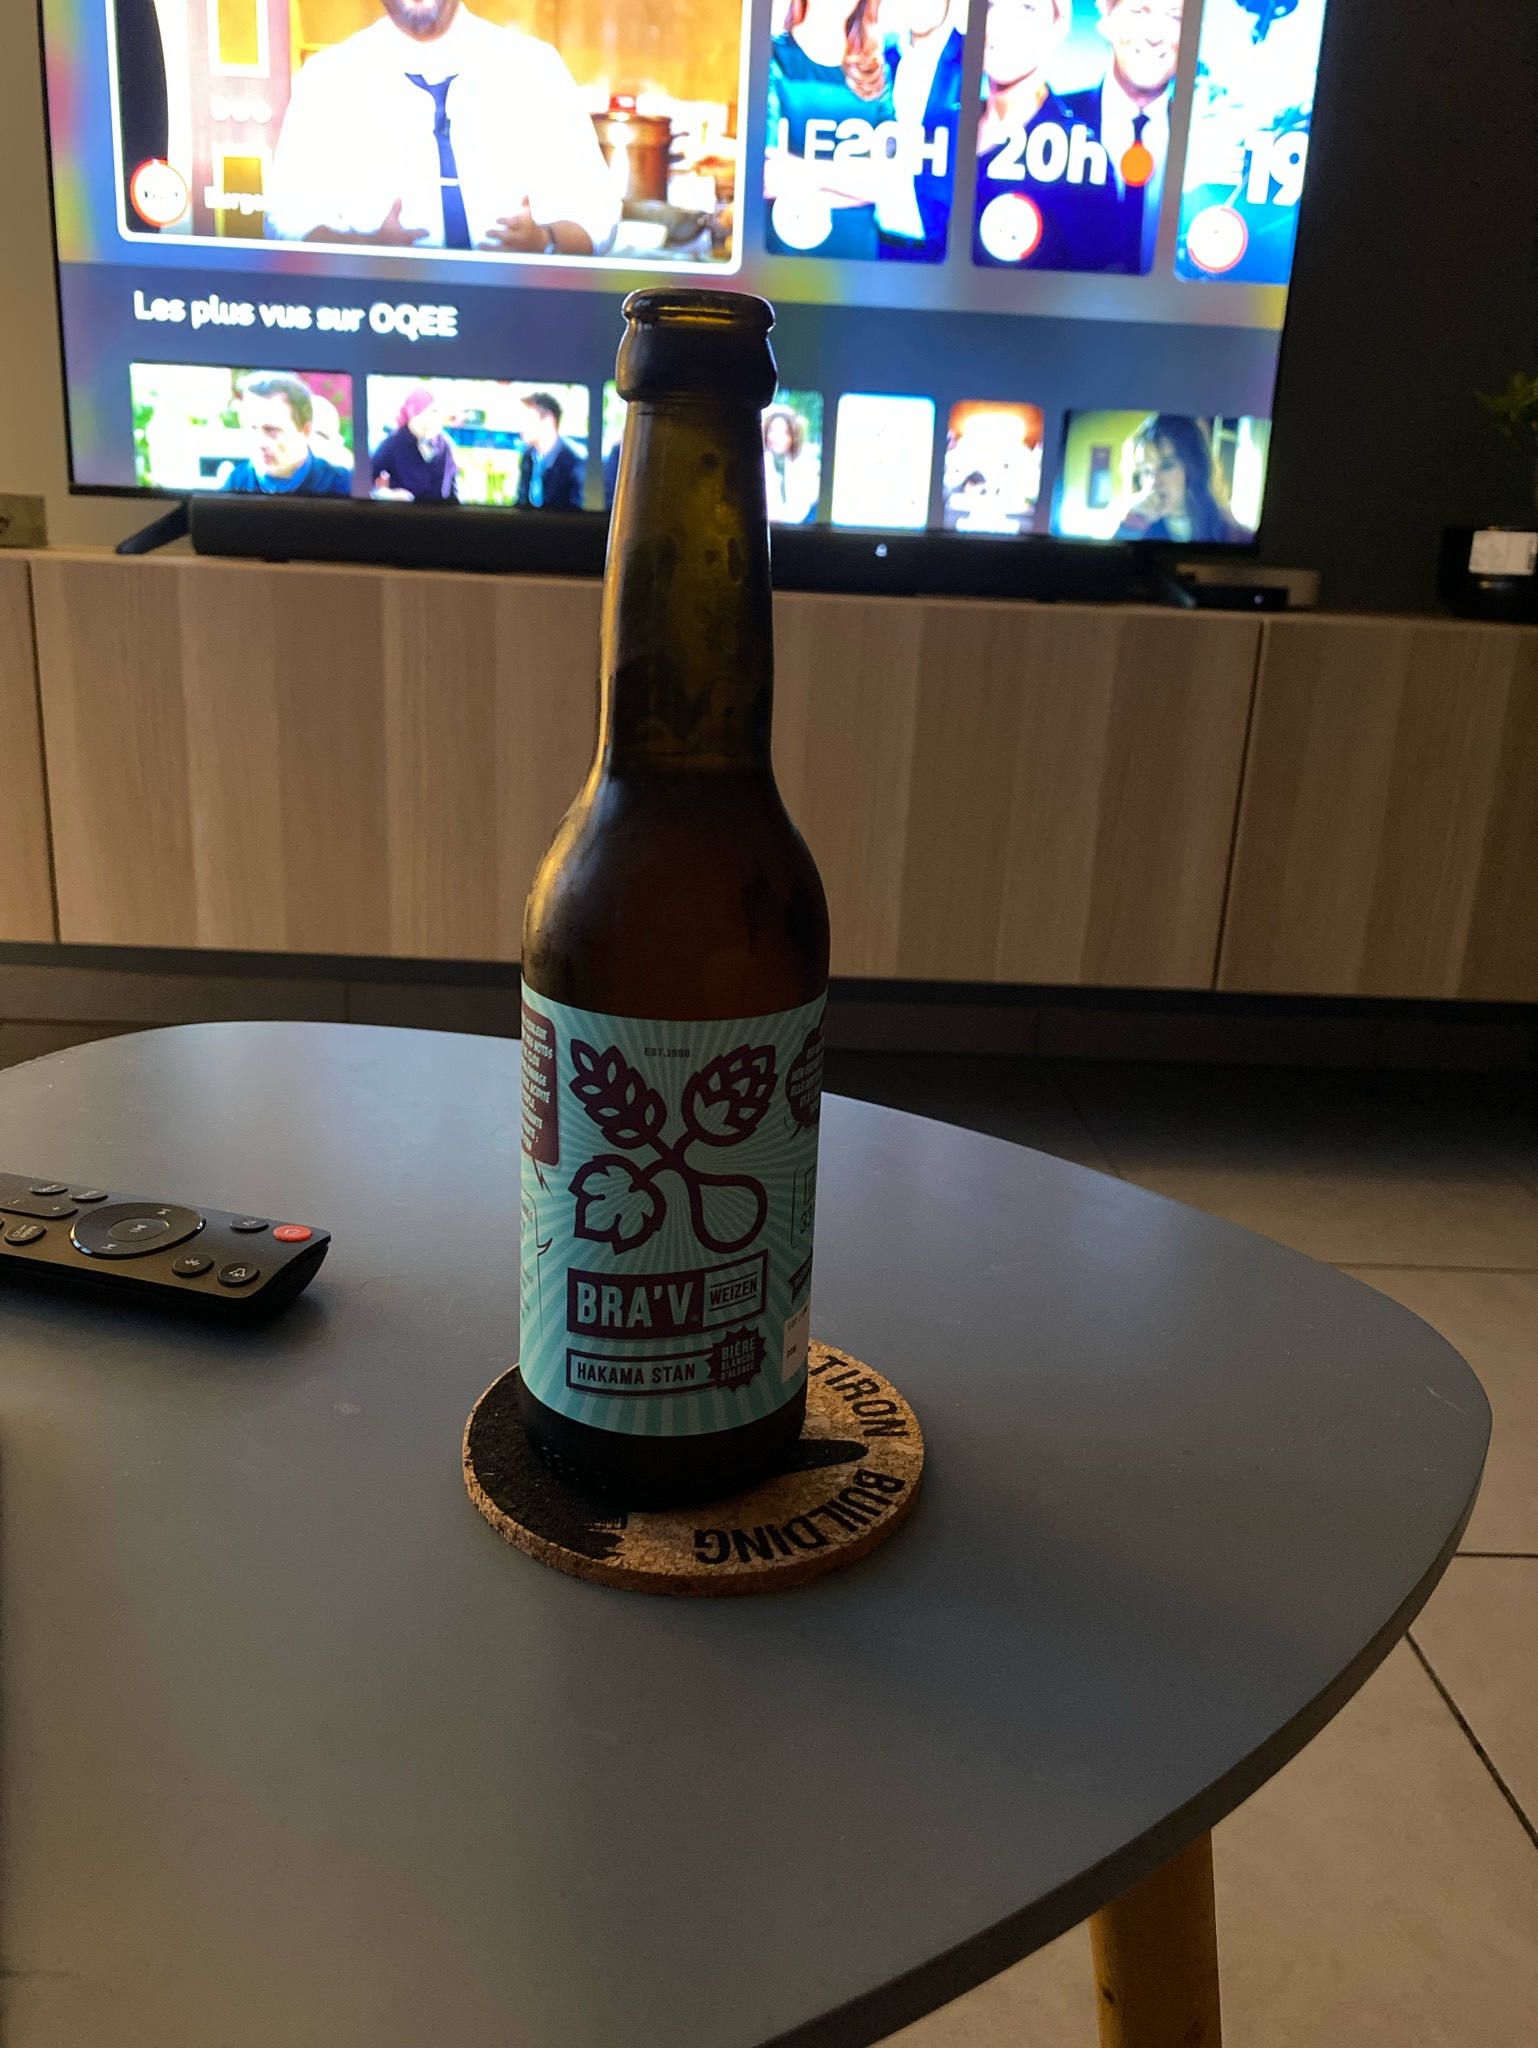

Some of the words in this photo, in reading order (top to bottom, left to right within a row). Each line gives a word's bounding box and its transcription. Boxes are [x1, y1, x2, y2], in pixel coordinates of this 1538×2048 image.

[987, 121, 1107, 185] 20h
[133, 289, 186, 322] Les
[191, 294, 255, 329] plus
[259, 303, 312, 329] vus
[316, 306, 365, 331] sur
[369, 303, 458, 341] OQEE
[577, 1281, 694, 1329] BRA'V
[710, 1278, 757, 1305] WEIZEN
[577, 1362, 644, 1385] HAKAMA
[652, 1363, 695, 1384] STAN
[722, 1336, 756, 1360] BIÈRE
[807, 1345, 909, 1437] TIRON
[694, 1468, 906, 1564] BUILDING
